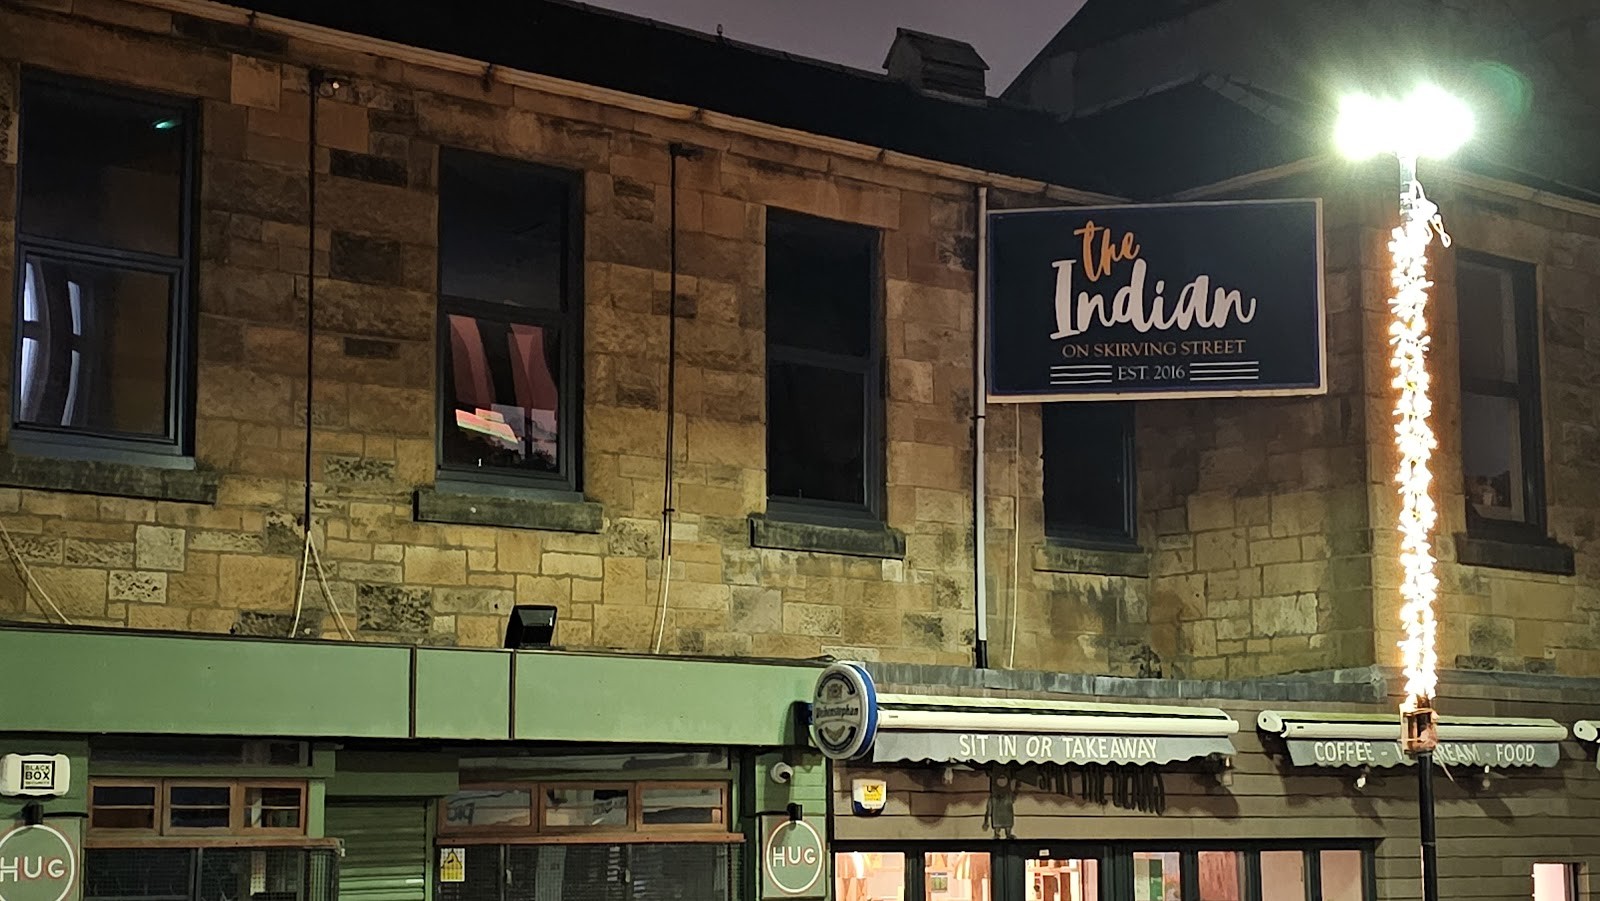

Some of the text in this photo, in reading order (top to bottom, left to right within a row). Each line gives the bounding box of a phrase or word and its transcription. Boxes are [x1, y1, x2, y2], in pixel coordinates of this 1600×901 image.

[1074, 220, 1140, 281] the
[1050, 258, 1256, 339] Indian
[1062, 340, 1246, 358] ON SKIRVING STREET
[1154, 365, 1185, 379] 2016
[959, 735, 1157, 758] SIT IN OR TAKEAWAY
[1314, 741, 1375, 762] COFFEE
[1496, 743, 1536, 762] FOOD
[25, 771, 50, 780] BOX
[772, 846, 816, 868] HUG
[0, 856, 65, 882] HUG
